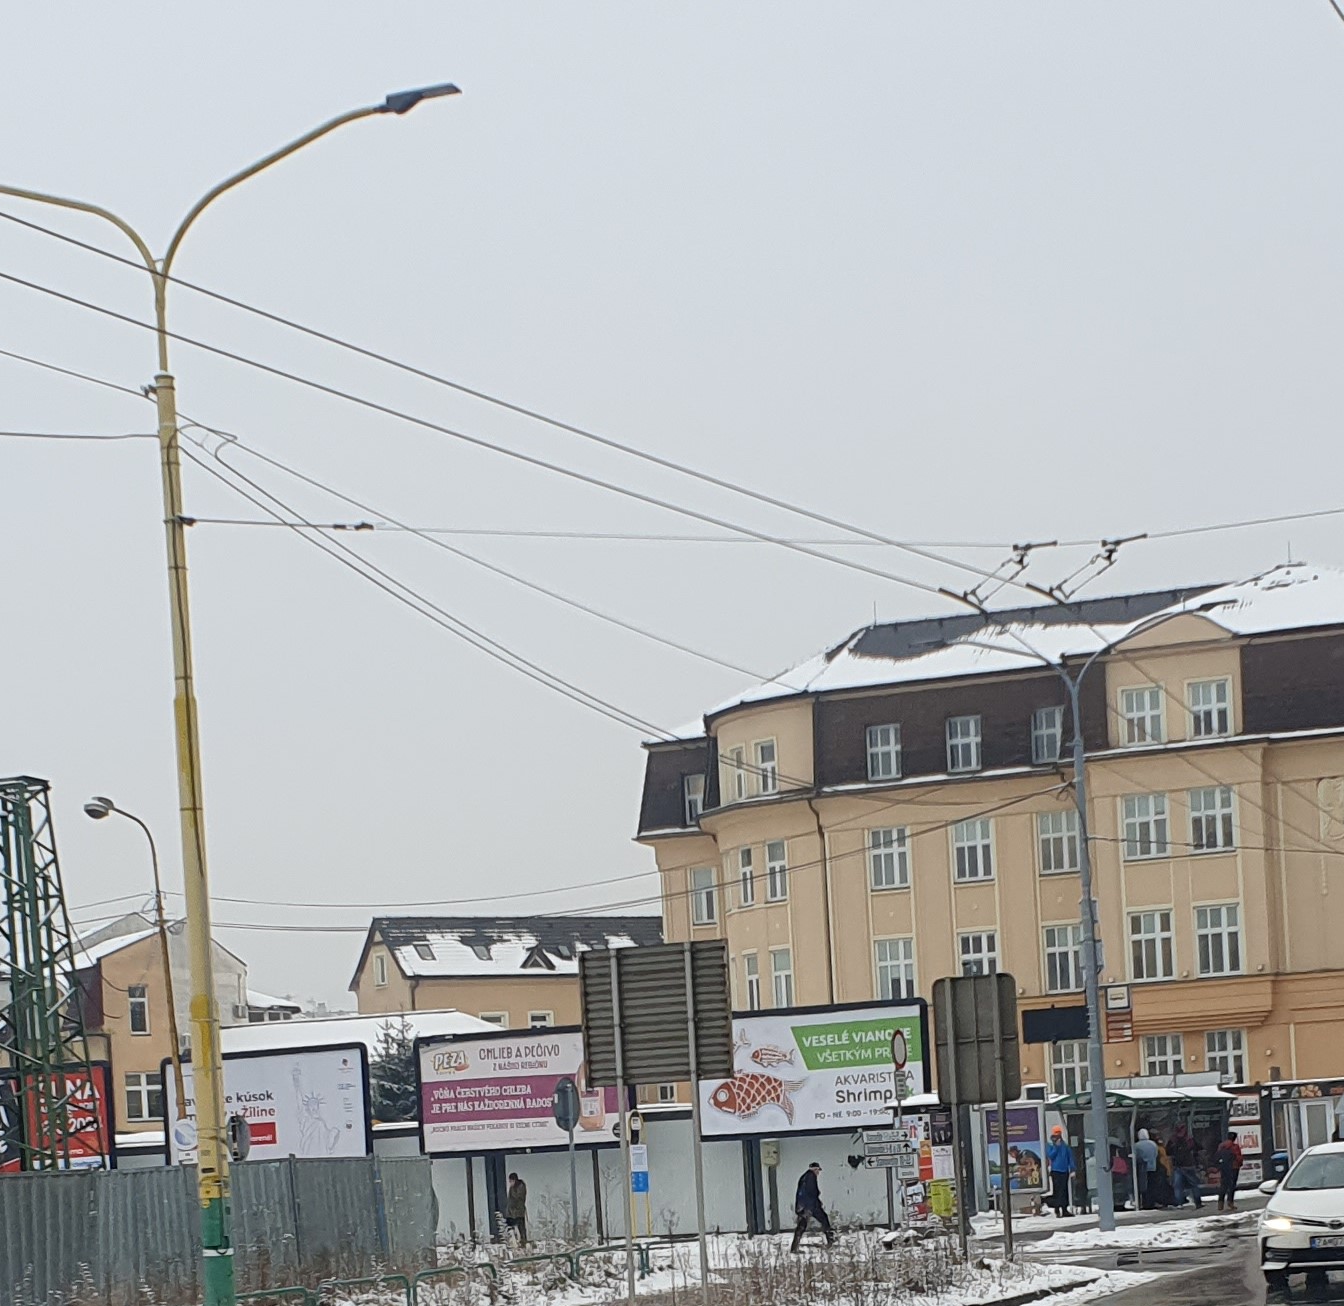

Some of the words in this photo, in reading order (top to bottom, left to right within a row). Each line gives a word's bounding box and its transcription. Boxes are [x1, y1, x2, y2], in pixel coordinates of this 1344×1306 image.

[802, 1030, 850, 1047] VESELÉ
[852, 1027, 912, 1043] VIANOE
[433, 1051, 467, 1071] PEZA
[479, 1048, 513, 1060] CHLIEB
[515, 1048, 523, 1058] A
[817, 1046, 872, 1063] VŠETKÝM
[874, 1045, 913, 1058] PRE
[835, 1070, 915, 1086] AKVARISTA
[236, 1090, 274, 1103] kúsok
[241, 1105, 276, 1118] Žiline
